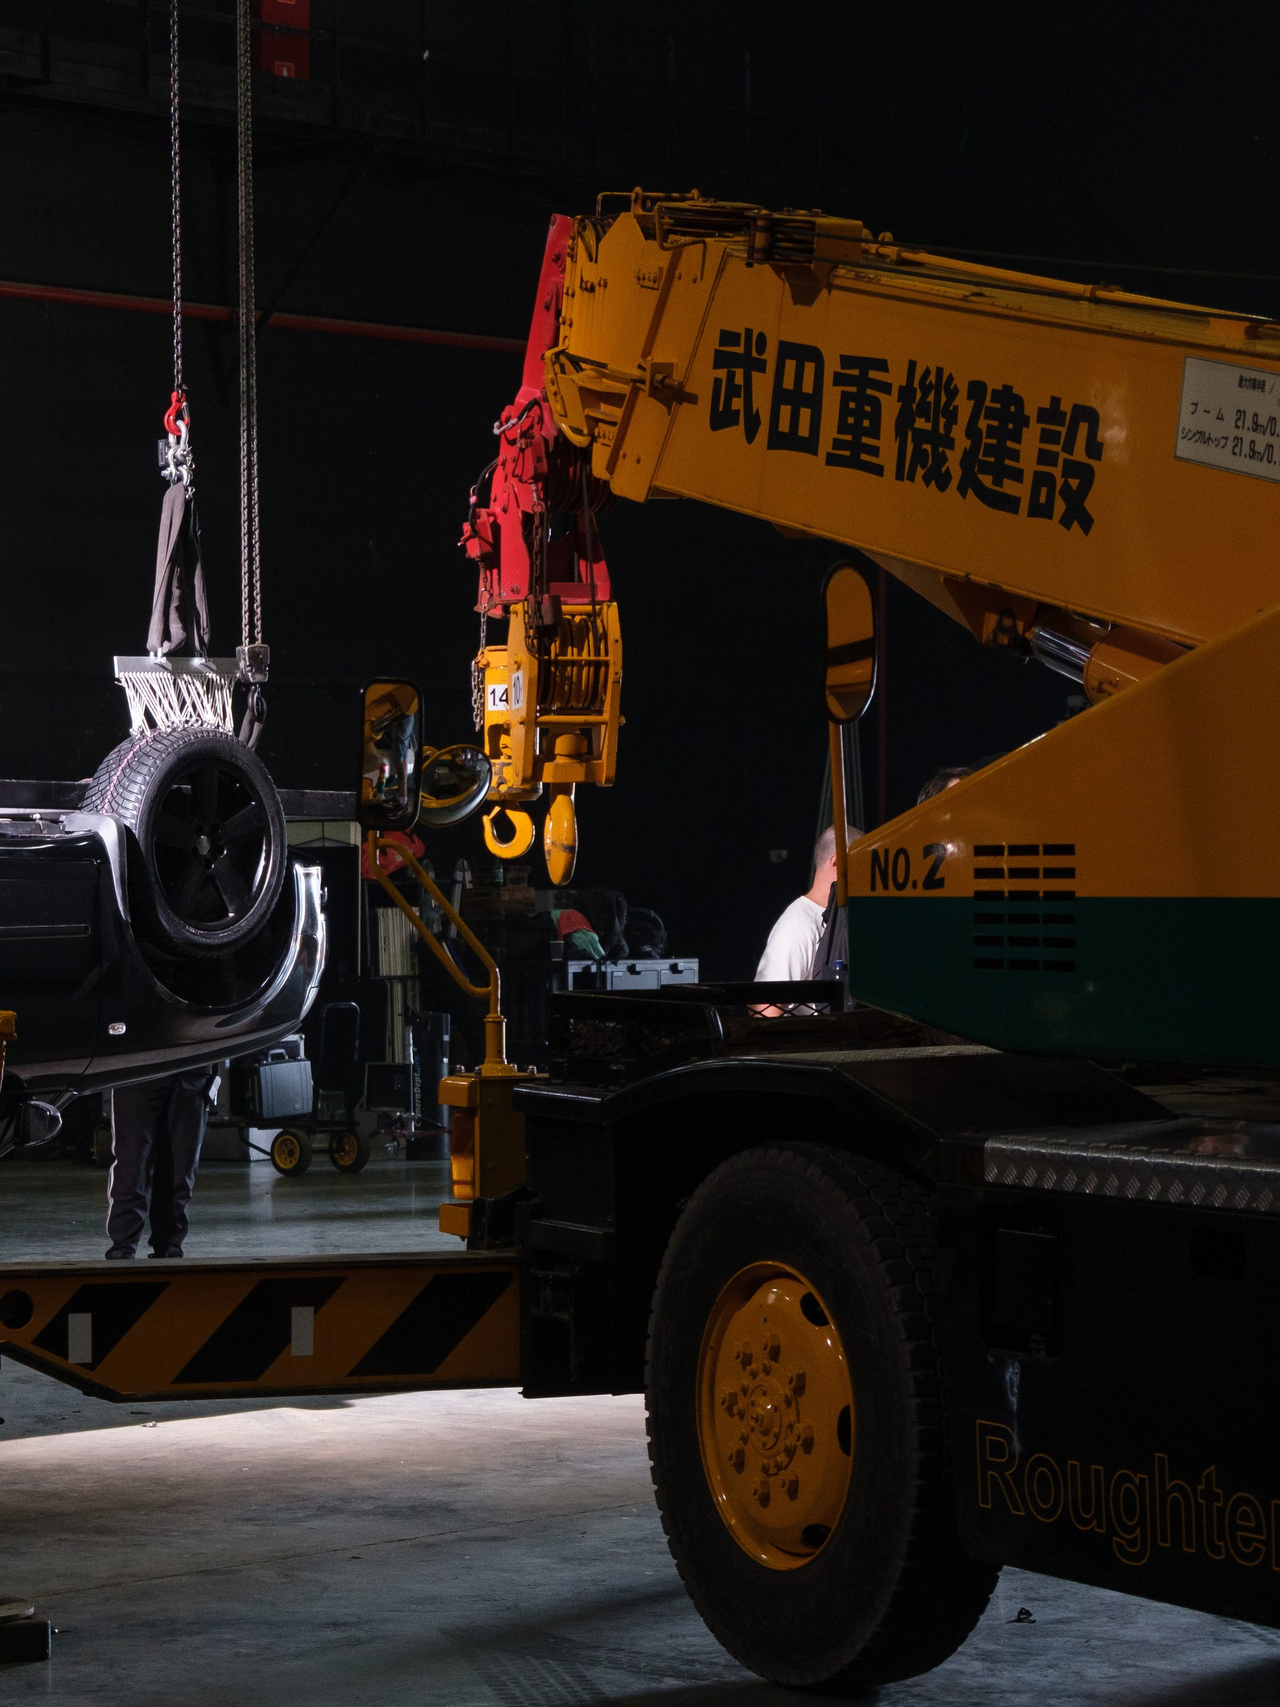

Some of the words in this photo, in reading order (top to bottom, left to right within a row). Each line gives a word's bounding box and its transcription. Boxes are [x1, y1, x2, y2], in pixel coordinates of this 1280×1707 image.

[709, 327, 1104, 537] 武田重機建設
[1231, 436, 1280, 465] 21.9m/0.
[490, 688, 509, 706] 14
[870, 842, 946, 891] NO.2
